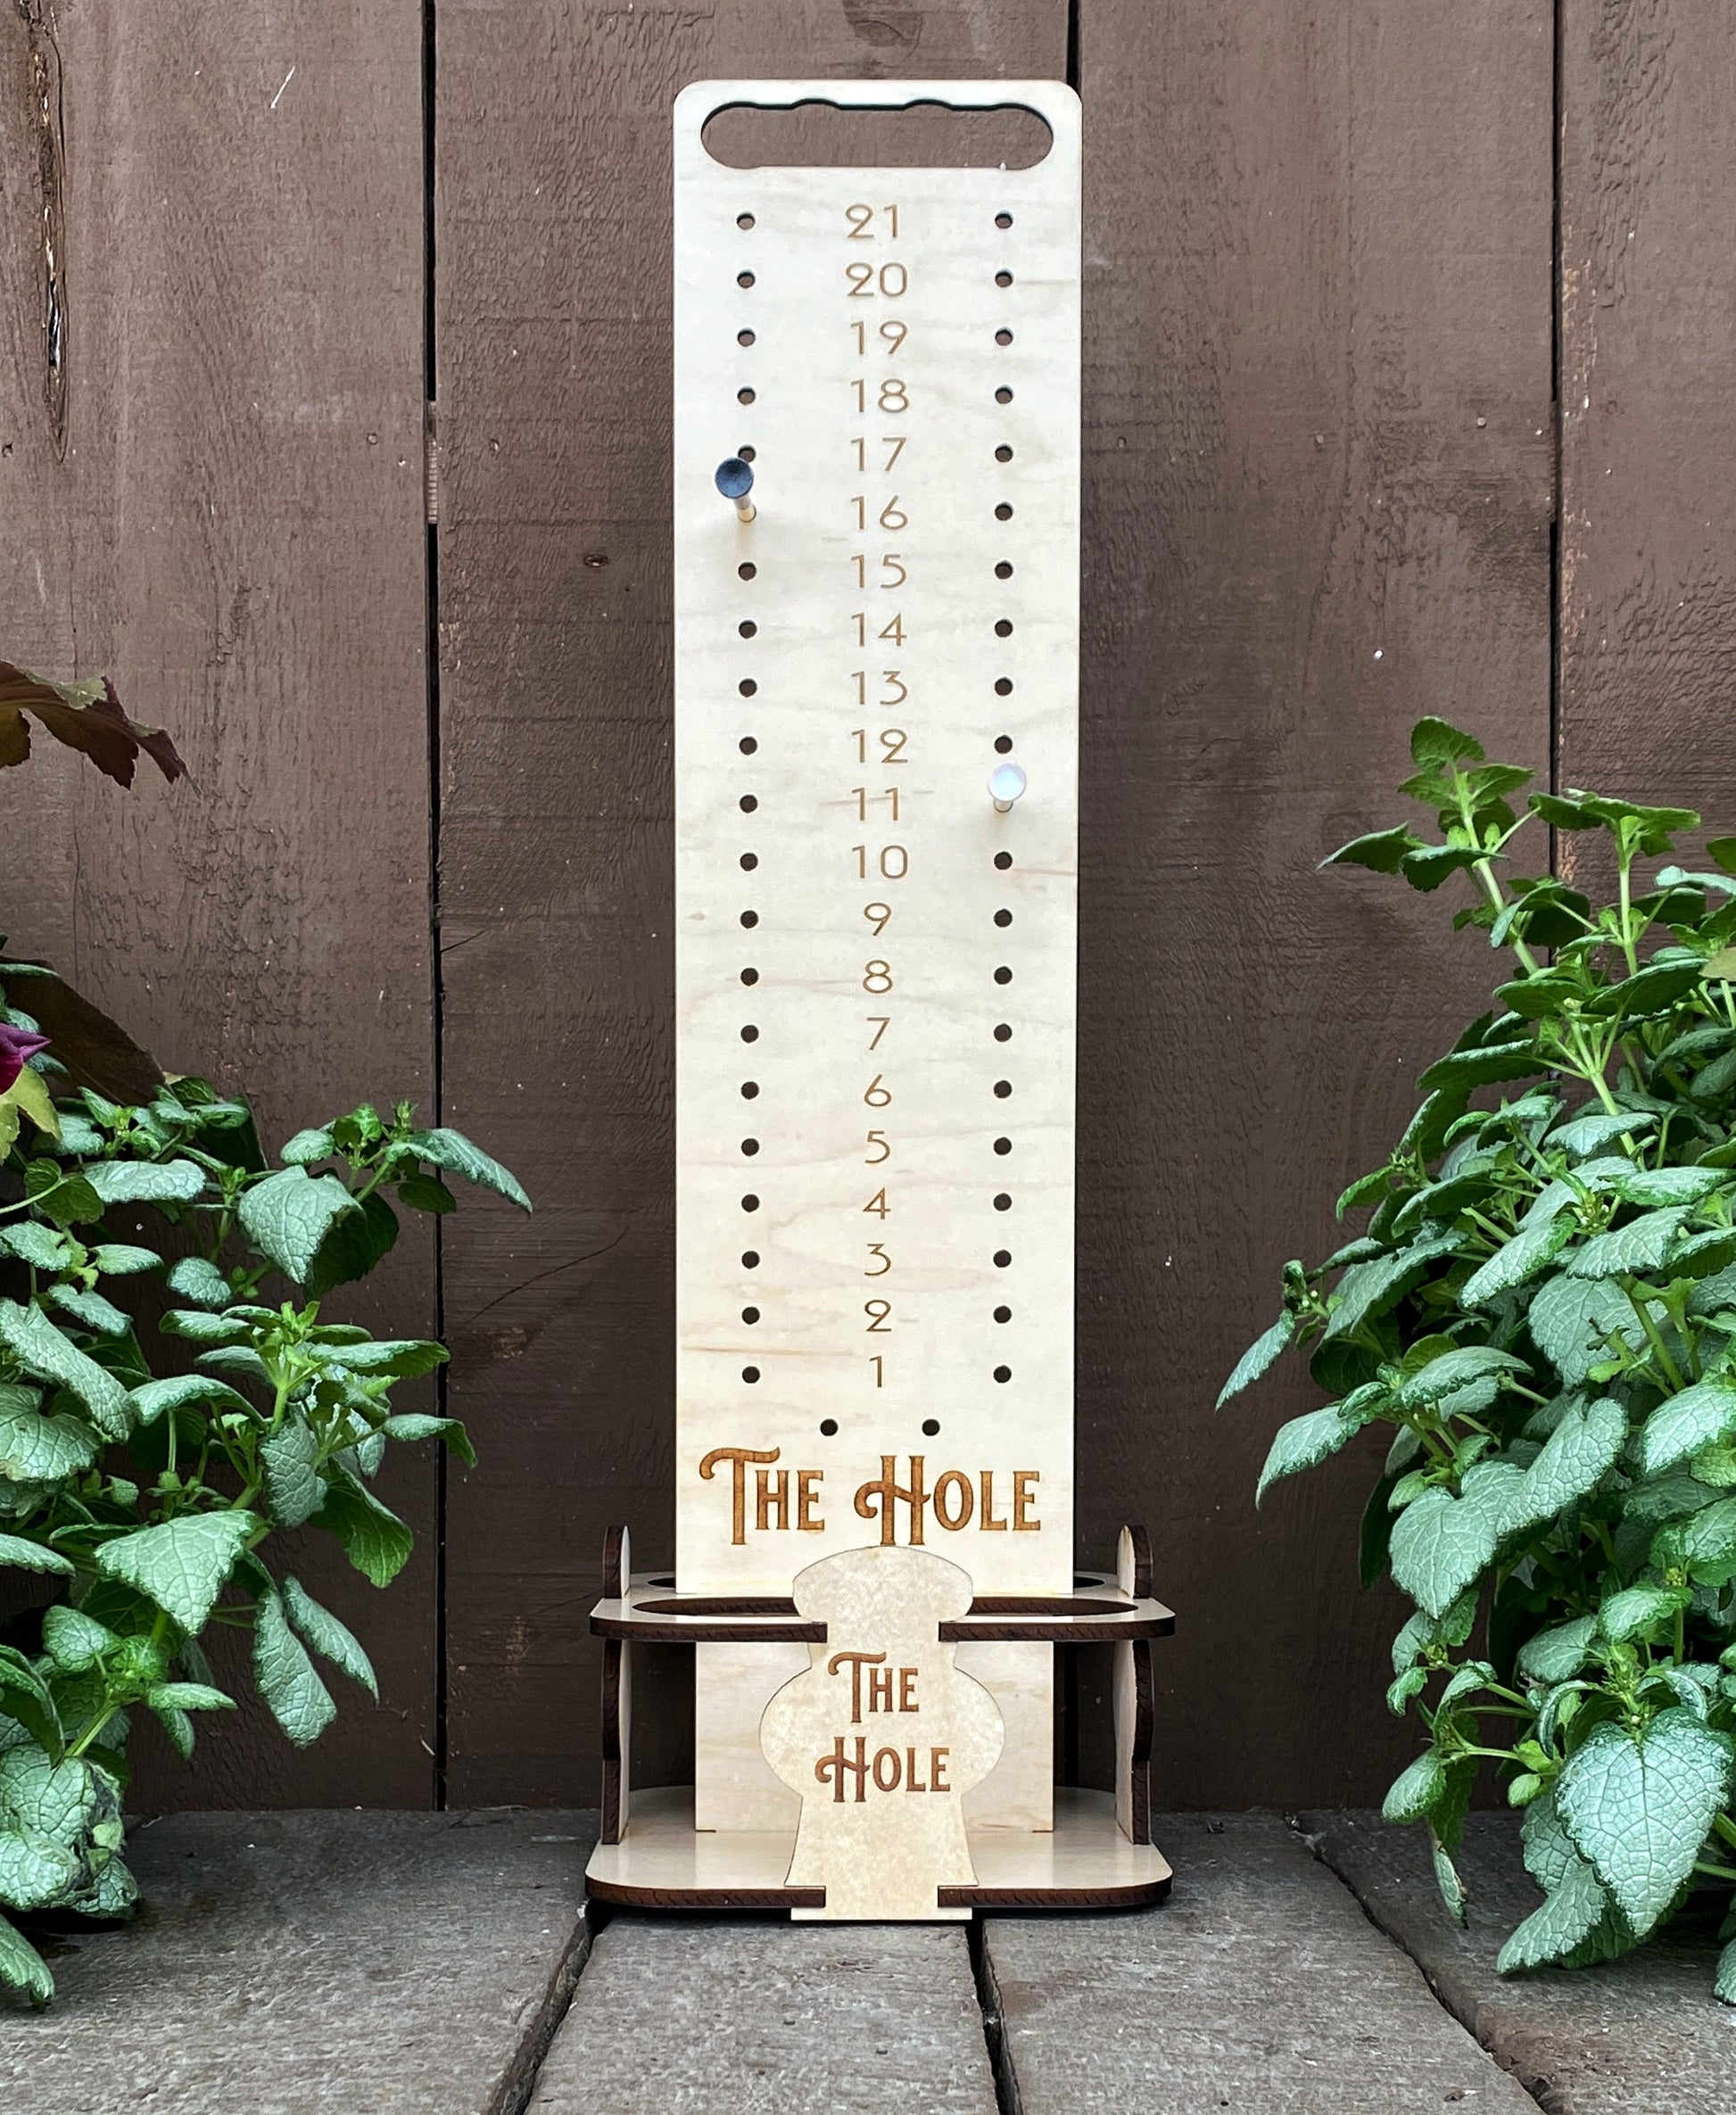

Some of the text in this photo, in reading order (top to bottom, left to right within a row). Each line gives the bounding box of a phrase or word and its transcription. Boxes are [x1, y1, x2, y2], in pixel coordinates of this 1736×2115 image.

[845, 204, 900, 239] 21
[846, 262, 908, 298] 20
[849, 321, 908, 355] 19
[849, 378, 910, 413] 18
[850, 437, 907, 472] 17
[850, 495, 909, 530] 16
[850, 554, 907, 588] 15
[851, 612, 908, 647] 14
[851, 671, 908, 706] 13
[851, 729, 908, 764] 12
[852, 787, 899, 821] 11
[852, 845, 908, 880] 10
[864, 902, 892, 937] 9
[863, 959, 893, 994] 8
[866, 1017, 890, 1051] 7
[864, 1073, 892, 1107] 6
[864, 1131, 891, 1164] 5
[863, 1187, 891, 1220] 4
[864, 1243, 891, 1276] 3
[864, 1300, 891, 1333] 2
[870, 1355, 882, 1389] 1
[699, 1447, 1041, 1546] THE HOLE
[827, 1651, 919, 1723] THE
[814, 1736, 951, 1803] HOLE
